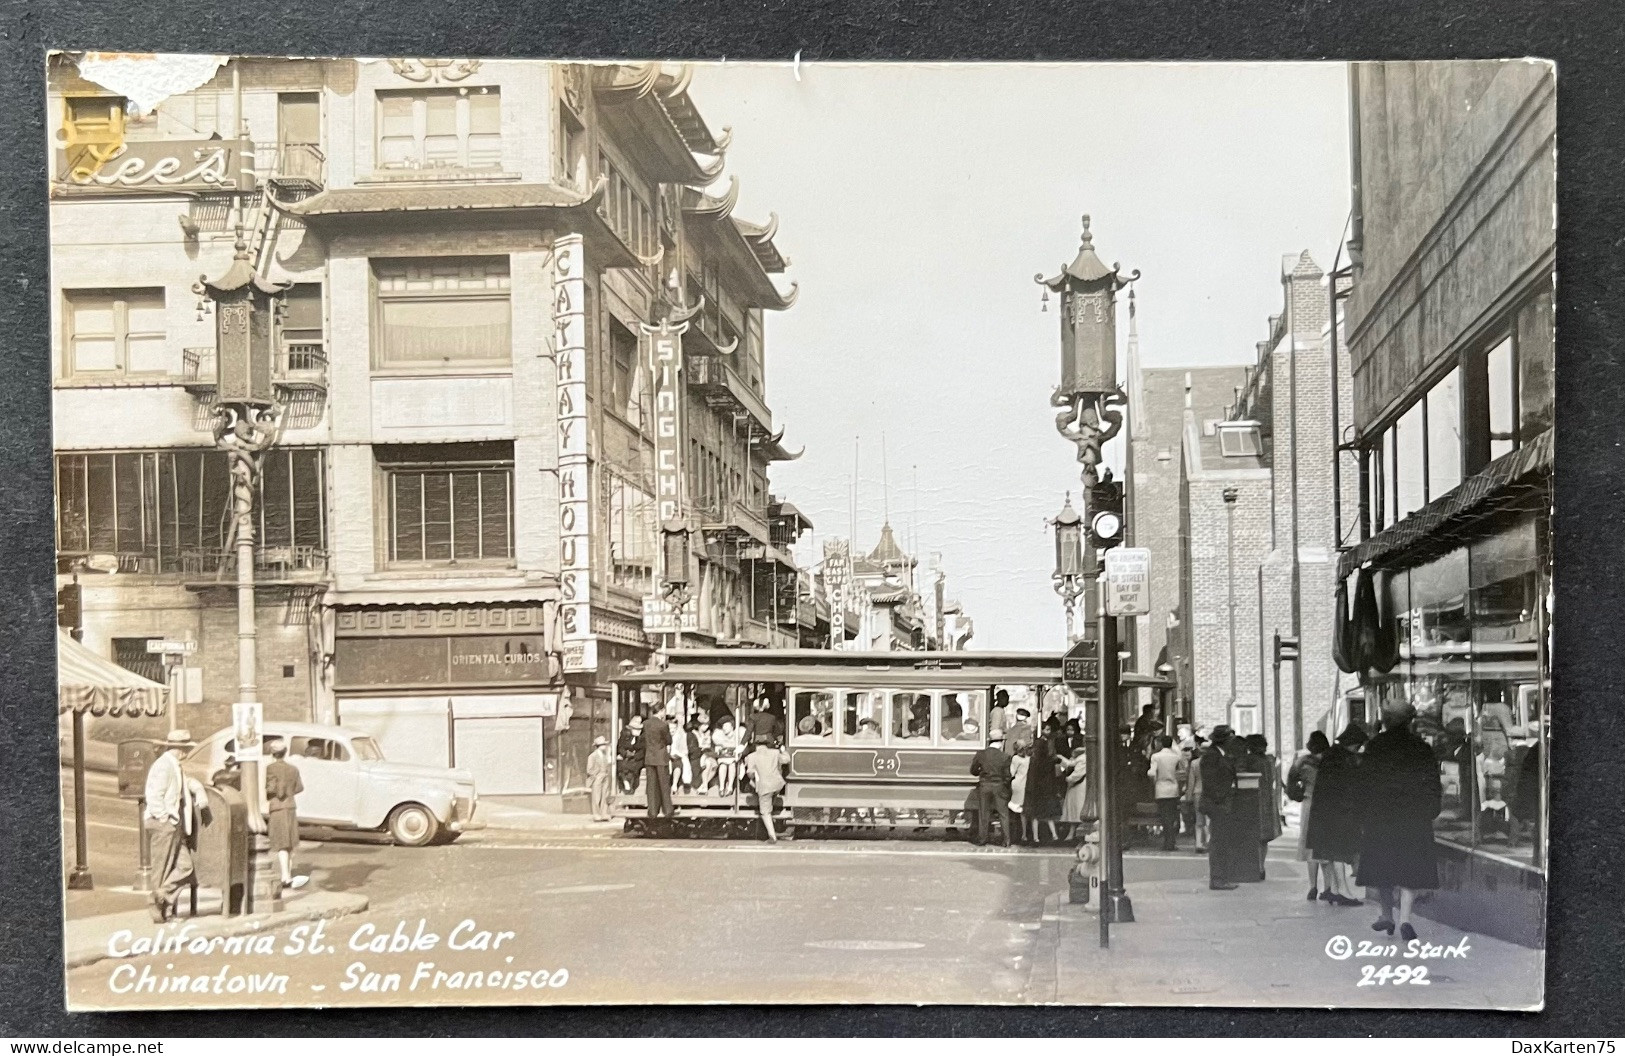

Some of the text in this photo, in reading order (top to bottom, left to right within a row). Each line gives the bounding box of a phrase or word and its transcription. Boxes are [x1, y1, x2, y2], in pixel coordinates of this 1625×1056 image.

[657, 338, 675, 438] SING
[555, 247, 578, 635] CATHAY HOUSE
[1111, 573, 1145, 583] OF STREET
[1117, 583, 1141, 592] DAY OR
[1120, 594, 1138, 602] NIGHT
[832, 589, 843, 639] CHOP
[452, 654, 502, 665] ORIENTAL
[876, 757, 896, 771] 23
